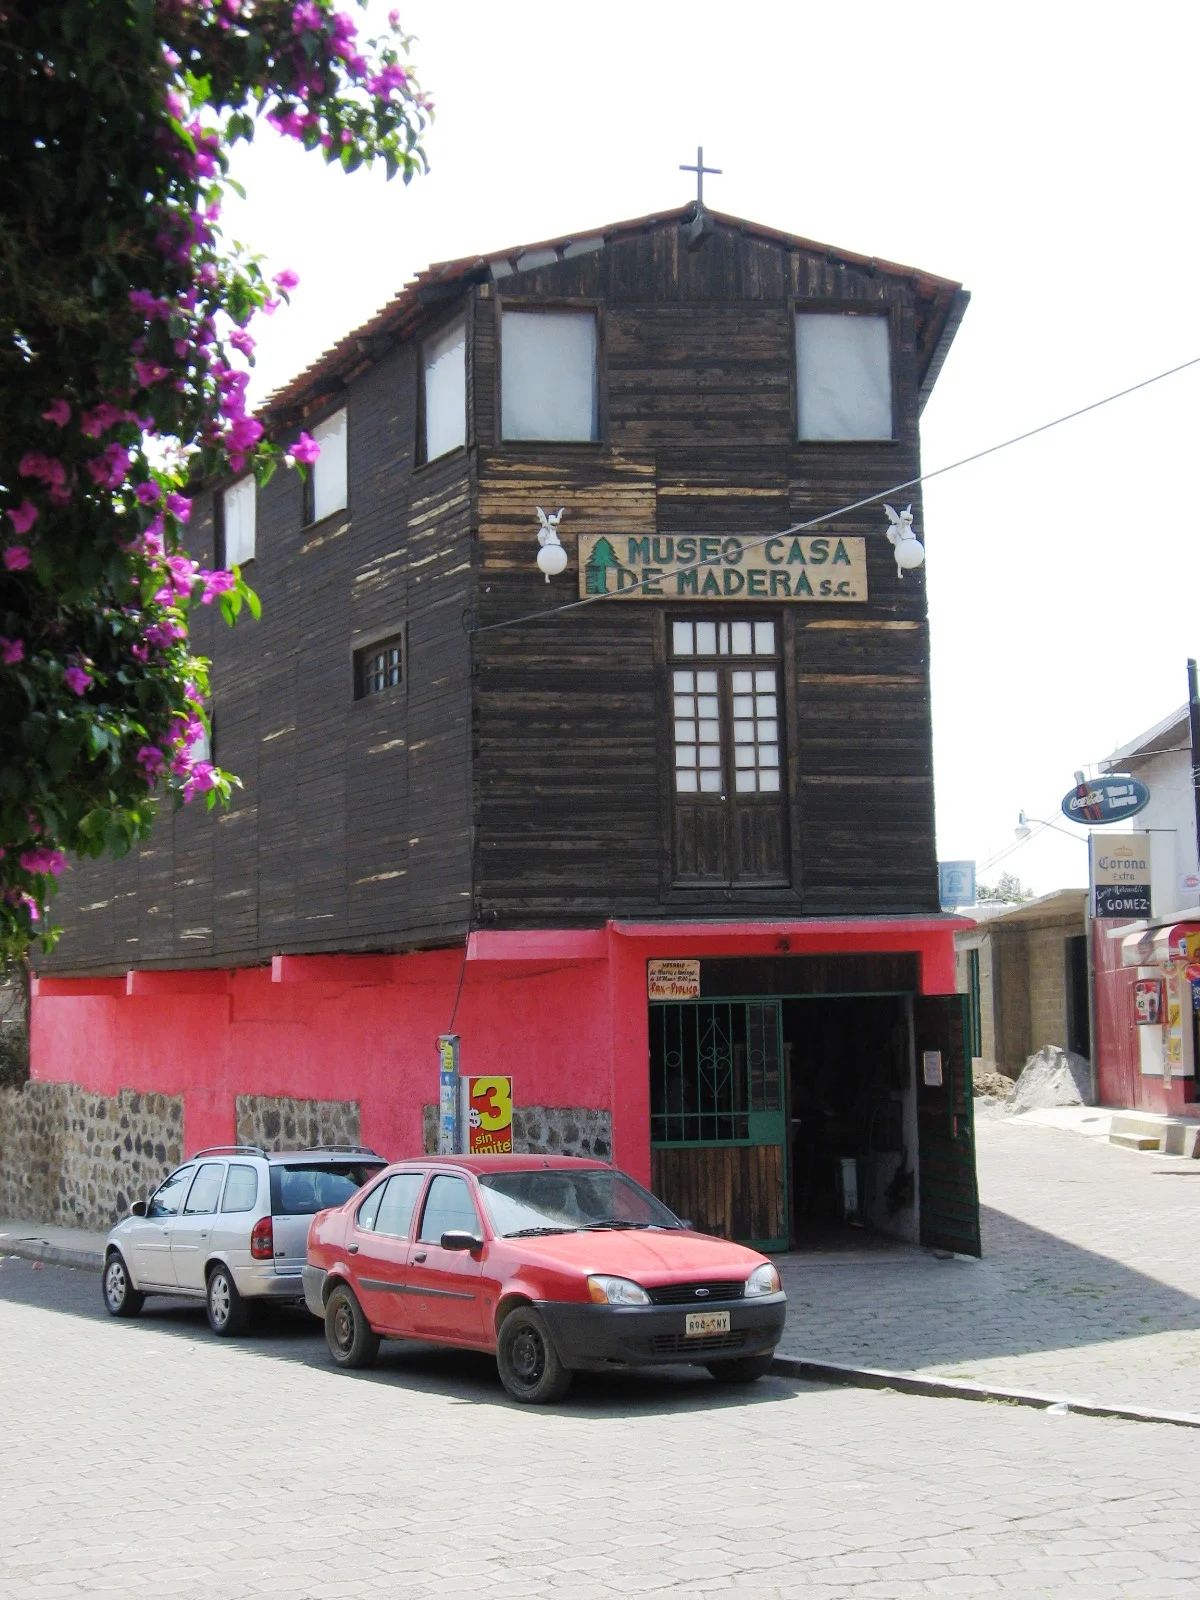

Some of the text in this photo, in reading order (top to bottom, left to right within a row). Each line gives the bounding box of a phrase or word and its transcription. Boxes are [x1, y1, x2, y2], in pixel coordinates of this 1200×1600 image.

[627, 536, 852, 566] MUSEO CASA
[616, 567, 665, 596] DE
[677, 567, 815, 597] MADERA
[1098, 856, 1147, 871] Corona
[1113, 871, 1135, 881] Extra
[1106, 898, 1148, 911] GOMEZ
[475, 1132, 493, 1145] sin
